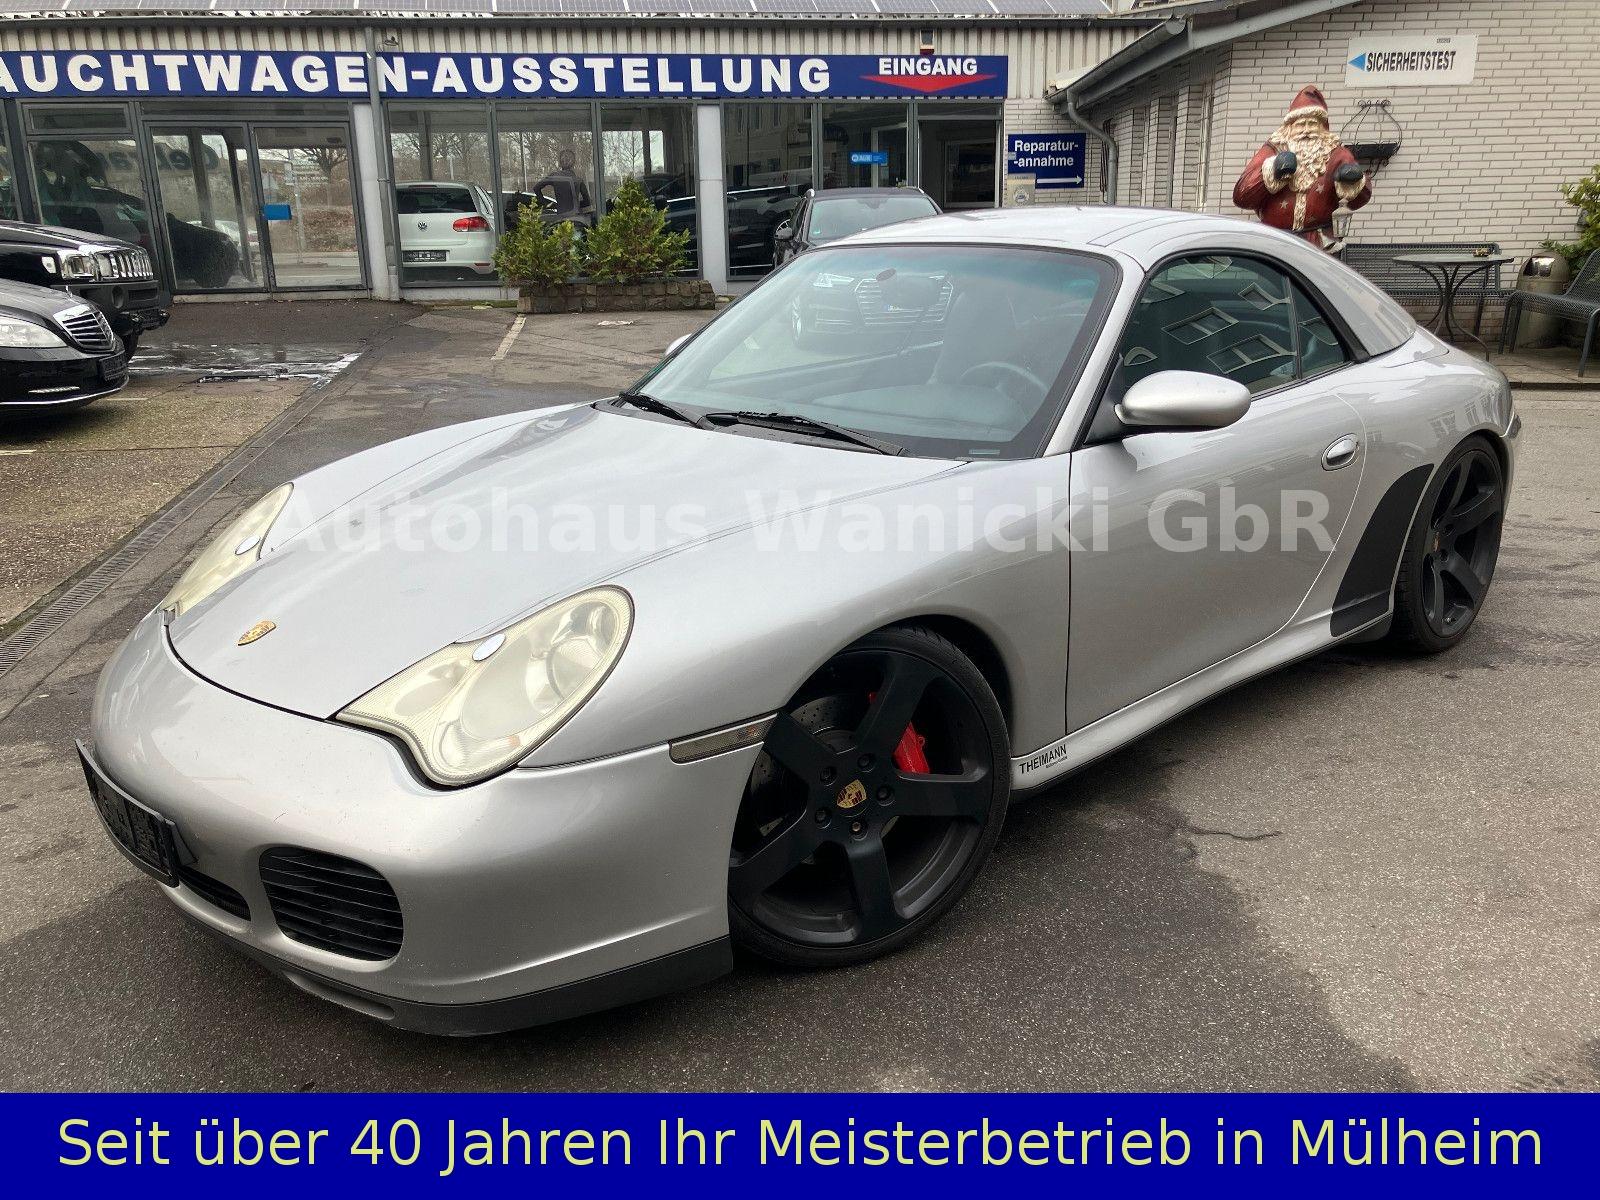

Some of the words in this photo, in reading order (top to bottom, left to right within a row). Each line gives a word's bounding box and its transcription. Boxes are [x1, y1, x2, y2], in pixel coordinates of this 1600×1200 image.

[879, 57, 978, 76] EINGANG
[1366, 50, 1457, 73] SICHERHEITSTEST
[1014, 139, 1079, 155] Reparatur-
[1013, 154, 1074, 168] -annahme
[1019, 744, 1067, 774] THEIMANN
